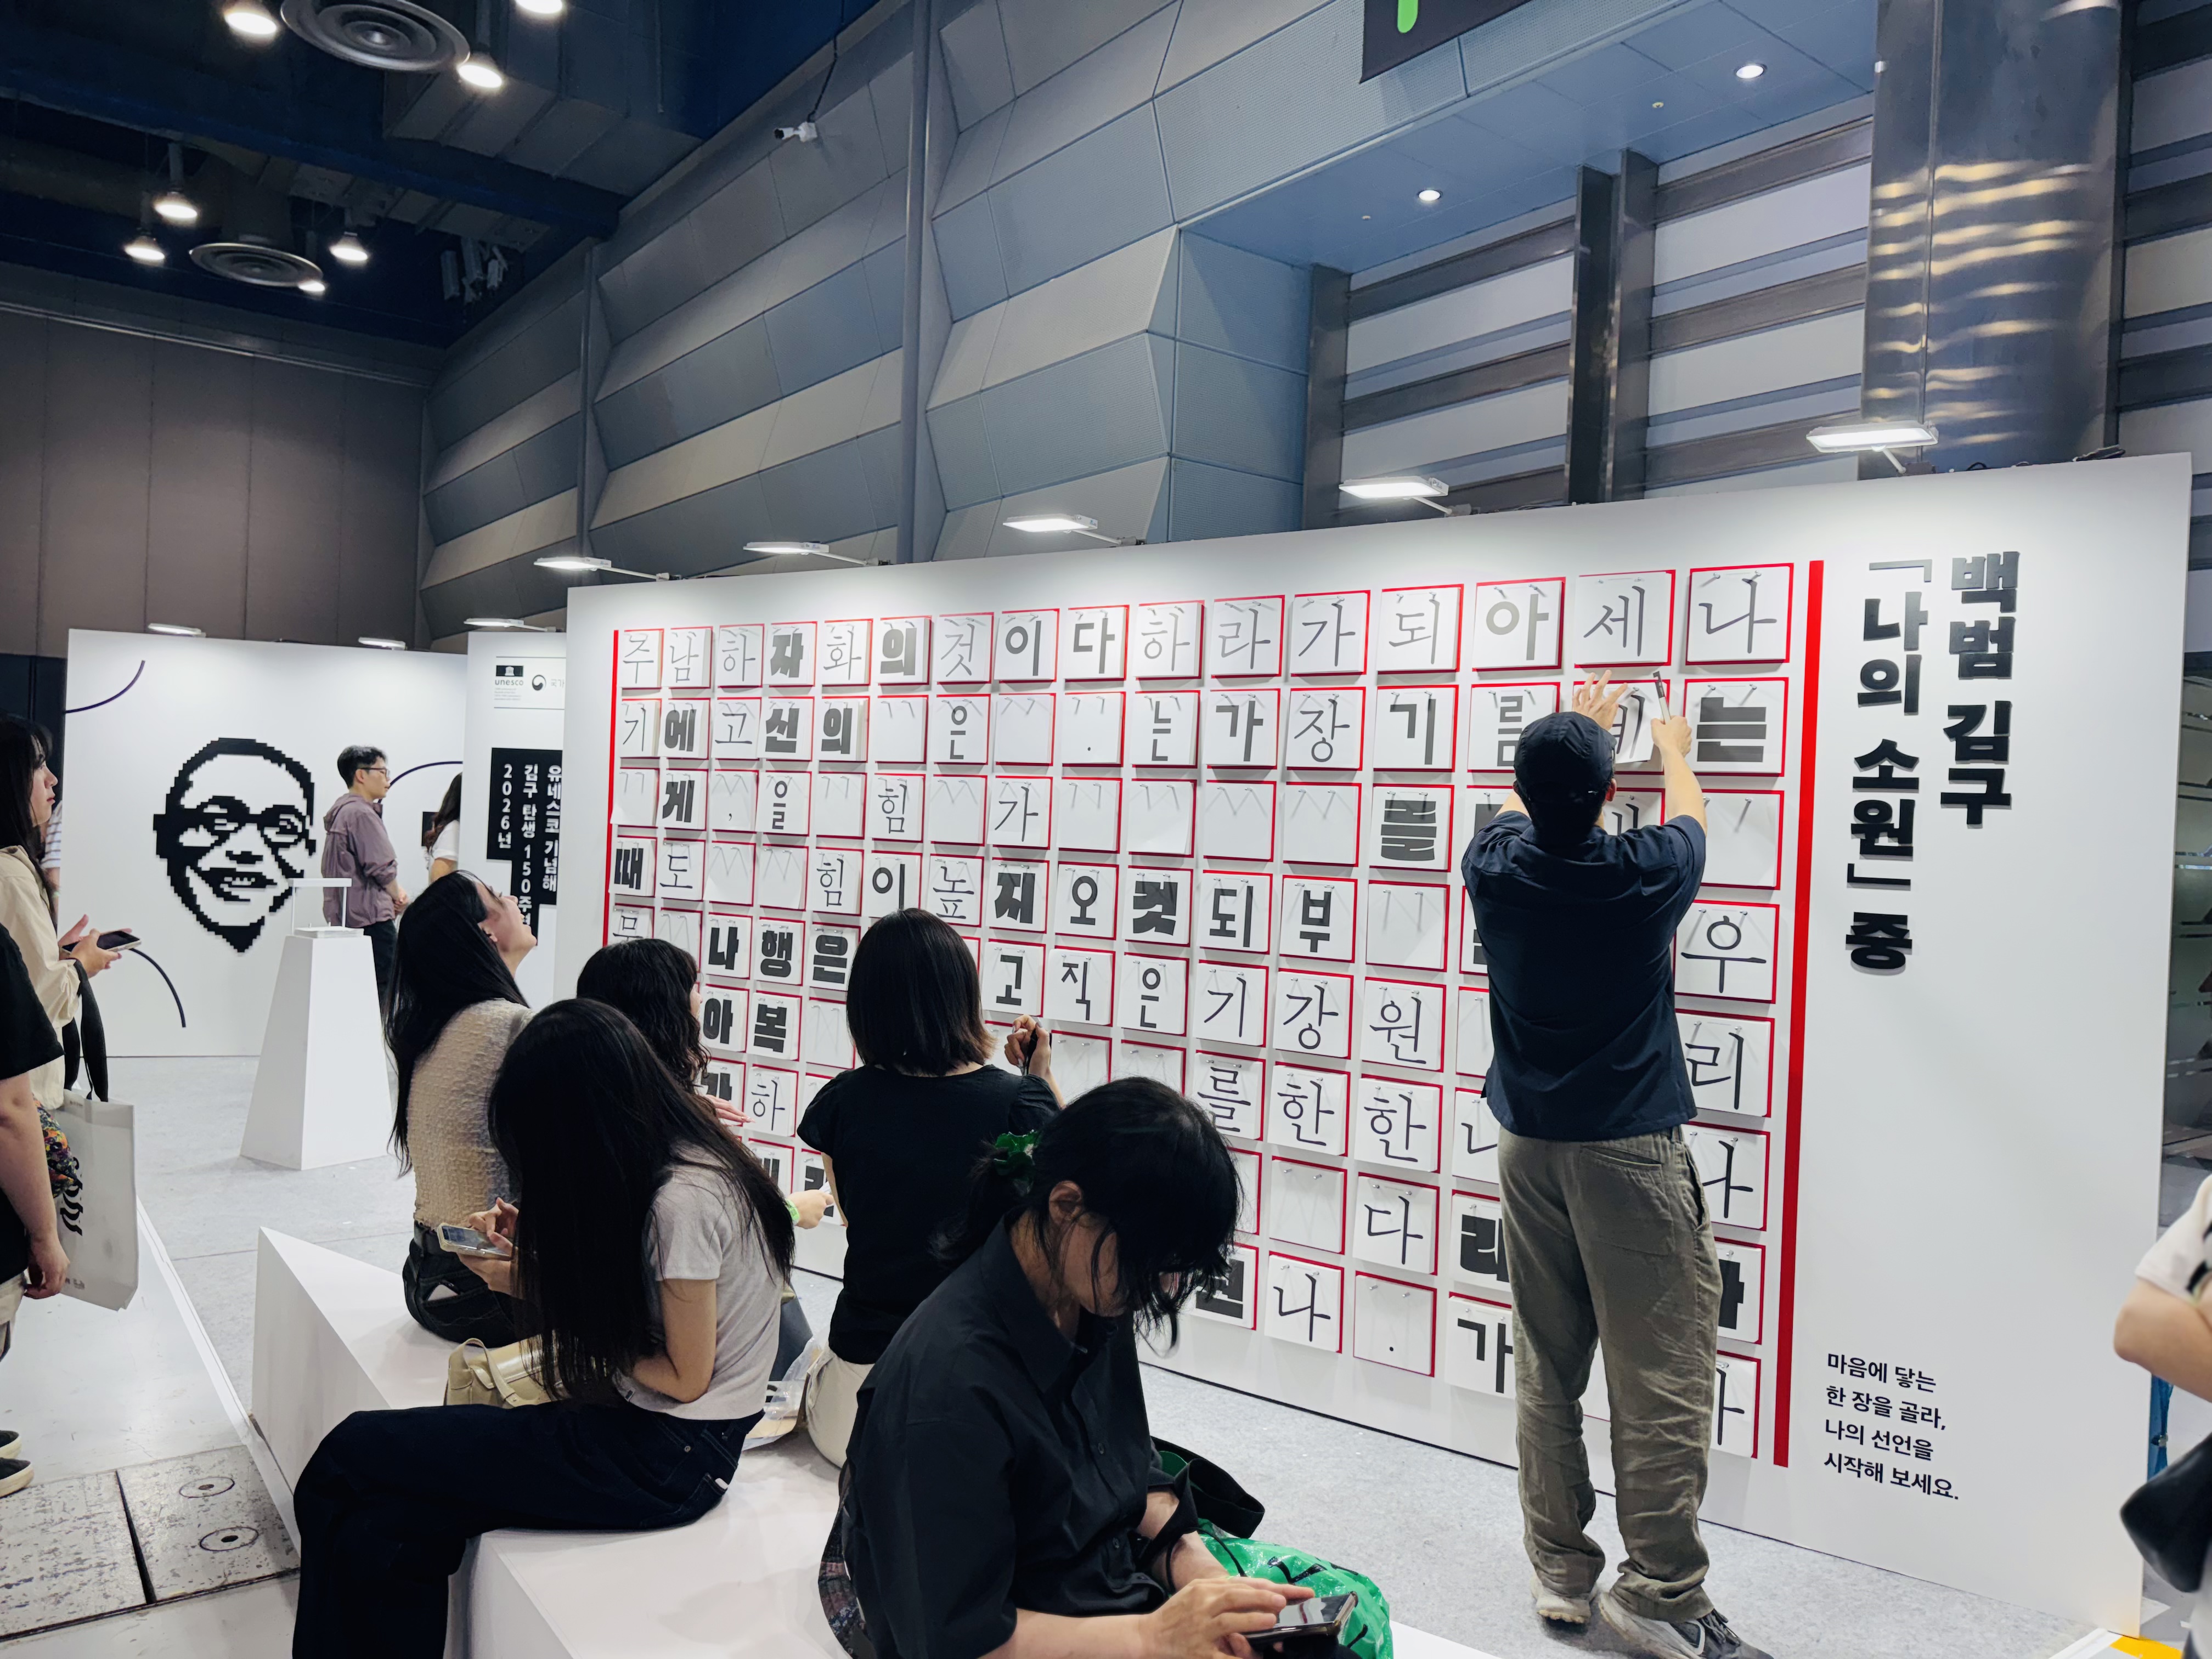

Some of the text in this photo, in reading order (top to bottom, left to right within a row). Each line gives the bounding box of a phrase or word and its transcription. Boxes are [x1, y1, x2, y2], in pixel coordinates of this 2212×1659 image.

[1141, 613, 1190, 672] 하
[1218, 608, 1271, 669] 라
[1299, 603, 1356, 667] 가
[1389, 599, 1440, 664] 되
[1486, 593, 1549, 661] 아
[1583, 585, 1645, 657] 세
[1698, 578, 1777, 653] 나
[623, 635, 654, 684] 주
[669, 634, 699, 681] 남
[721, 630, 755, 681] 하
[770, 633, 804, 678] 자
[824, 629, 861, 679] 화
[880, 628, 917, 675] 의
[941, 623, 974, 676] 것
[1005, 620, 1042, 676] 이
[1073, 618, 1115, 674] 다
[1940, 551, 2019, 828] 백범 김구
[623, 707, 645, 752] 기
[664, 709, 697, 752] 에
[714, 713, 752, 744] 고
[821, 708, 853, 754] 의
[950, 705, 967, 760] 은
[1152, 701, 1171, 761] 는
[1216, 701, 1263, 762] 가
[1294, 698, 1350, 762] 장
[1390, 698, 1436, 765] 기
[1696, 697, 1767, 762] 는
[498, 763, 512, 849] 2026년
[523, 764, 538, 799] 김구
[662, 780, 695, 822] 게
[772, 780, 787, 830] 을
[878, 783, 907, 833] 힘
[521, 804, 537, 838] 탄생
[542, 765, 562, 892] 유네스코 기념해
[995, 786, 1039, 842] 가
[1380, 799, 1437, 861] 를
[614, 847, 644, 889] 때
[659, 854, 693, 889] 도
[816, 858, 844, 907] 힘
[872, 864, 905, 909] 이
[933, 866, 974, 919] 높
[1070, 876, 1097, 925] 오
[1210, 886, 1254, 947] 되
[1300, 890, 1331, 952] 부
[708, 927, 739, 969] 나
[812, 934, 848, 984] 은
[1681, 916, 1767, 993] 우
[1846, 912, 1912, 971] 중
[996, 955, 1023, 1006] 고
[1061, 962, 1091, 1020] 직
[1141, 968, 1161, 1028] 은
[1204, 977, 1246, 1037] 기
[703, 998, 733, 1043] 아
[1283, 985, 1338, 1049] 강
[1370, 997, 1426, 1063] 원
[1198, 1066, 1251, 1132] 를
[1685, 1032, 1743, 1110] 리
[751, 1079, 785, 1131] 하
[1278, 1080, 1334, 1146] 한
[1364, 1094, 1426, 1162] 한
[1364, 1196, 1423, 1265] 다
[1273, 1273, 1330, 1342] 나
[1458, 1318, 1513, 1393] 가
[1827, 1353, 1936, 1392] 마음에 닿는
[1826, 1385, 1945, 1430] 한 장을 골라,
[1825, 1419, 1933, 1460] 나의 선언을
[1824, 1453, 1959, 1499] 시작해 보세요.
